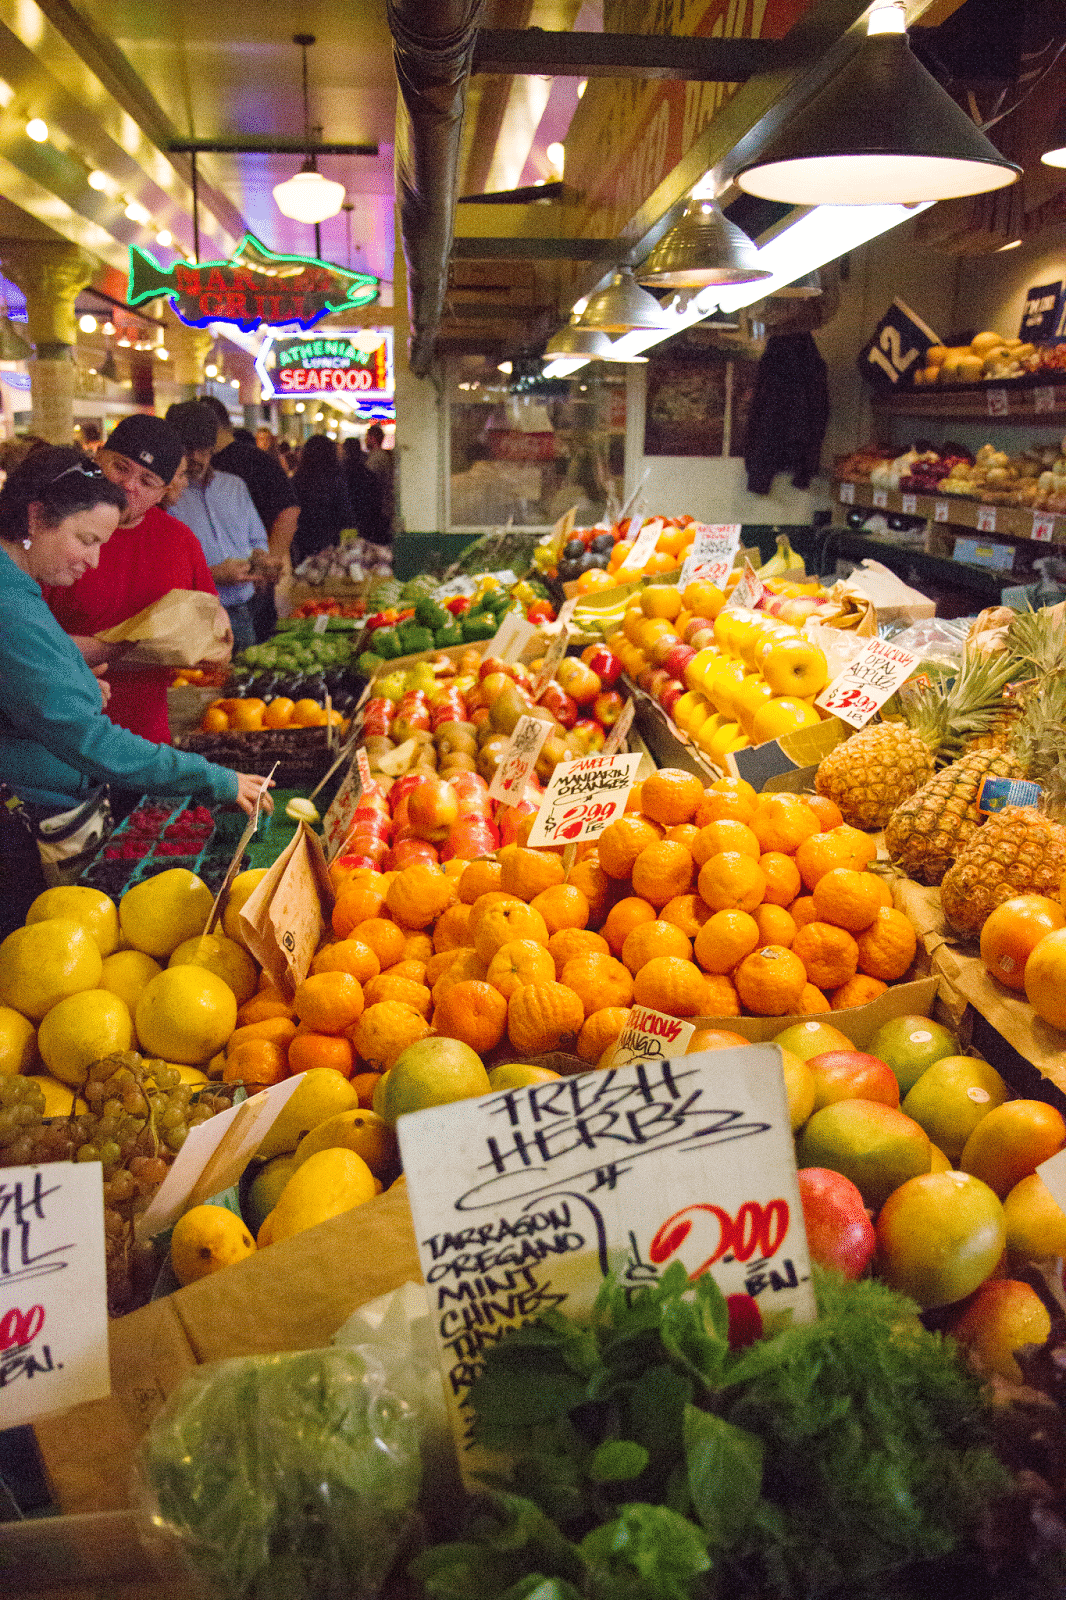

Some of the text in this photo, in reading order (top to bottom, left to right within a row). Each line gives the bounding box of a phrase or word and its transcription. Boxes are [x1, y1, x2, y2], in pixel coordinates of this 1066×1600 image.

[199, 292, 316, 319] GRILL
[280, 340, 370, 366] ATHENIAN
[868, 325, 919, 384] 12
[279, 368, 373, 391] SEAFOOD
[847, 661, 897, 688] APPLES
[864, 654, 897, 675] OPAL
[553, 764, 630, 788] MANDARIN
[568, 754, 620, 775] SWEET
[557, 776, 630, 796] ORANGES
[478, 1060, 701, 1126] FRESH
[478, 1089, 745, 1173] HERBS
[422, 1200, 572, 1260] TARRAGON
[426, 1232, 585, 1284] OREGANO
[438, 1260, 541, 1310] MINT
[440, 1281, 569, 1339] CHIVES
